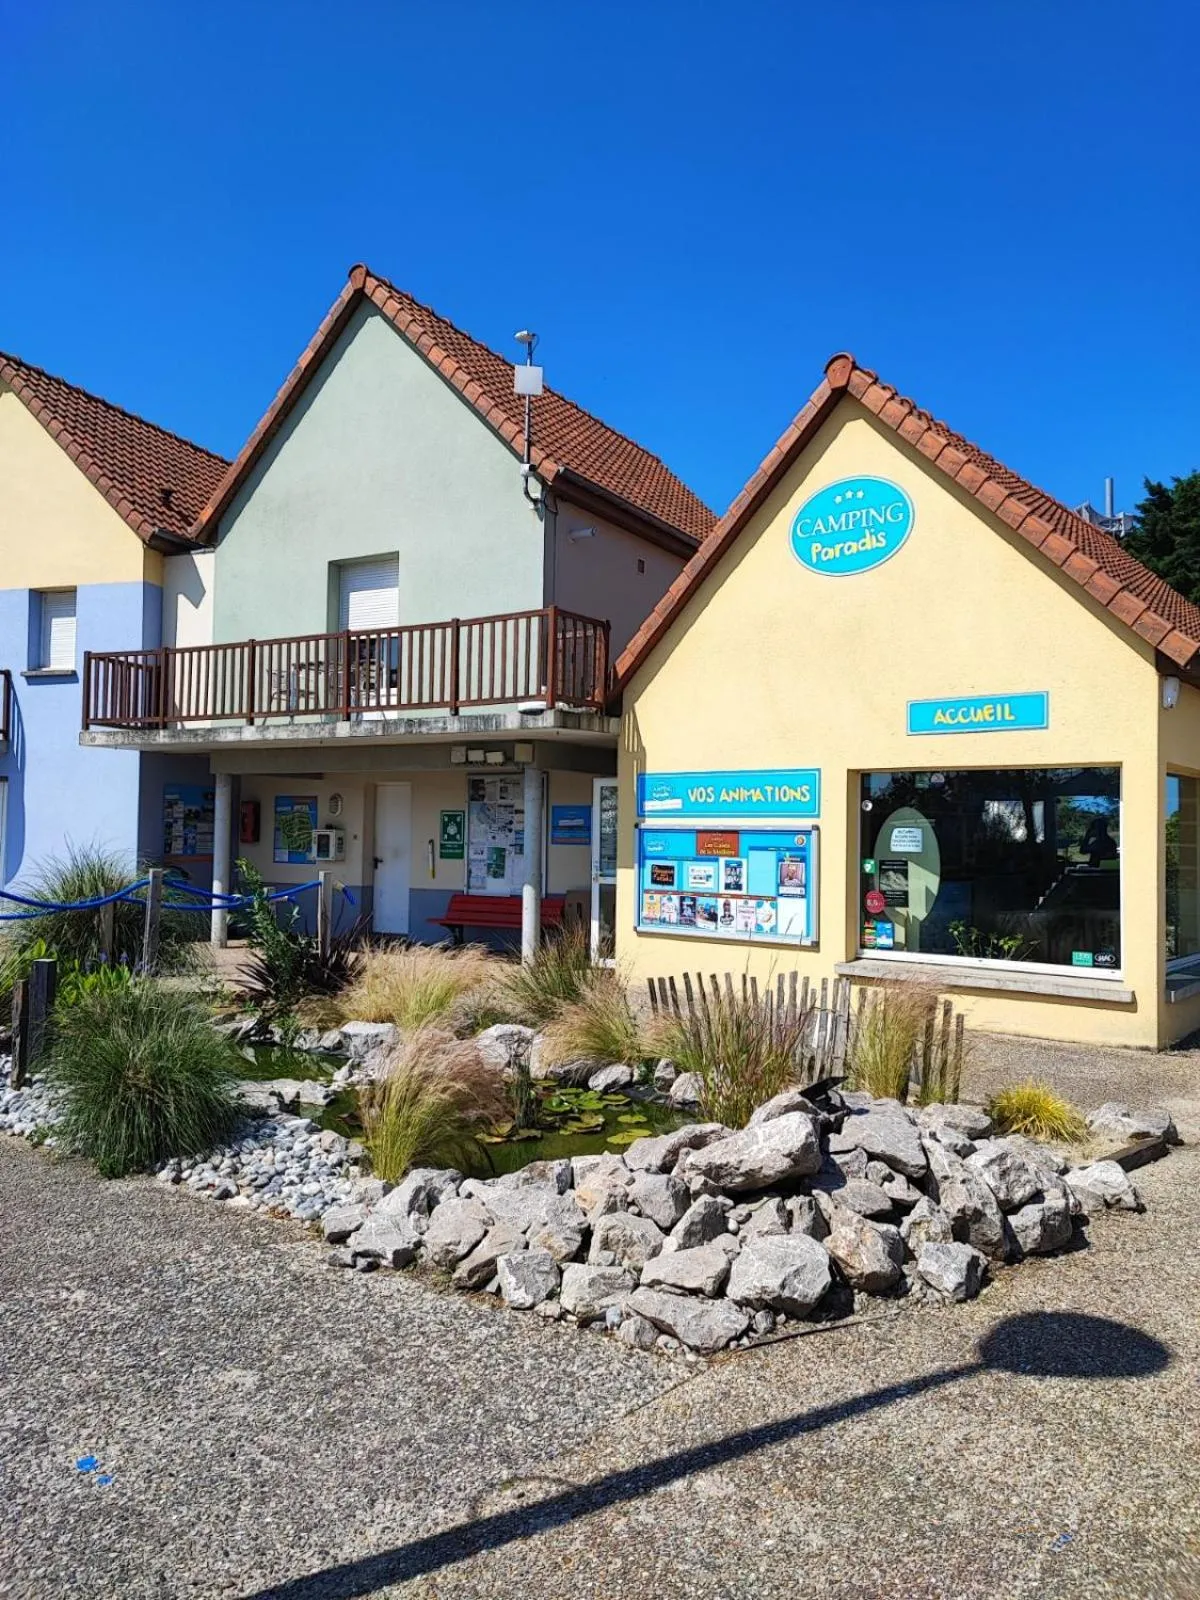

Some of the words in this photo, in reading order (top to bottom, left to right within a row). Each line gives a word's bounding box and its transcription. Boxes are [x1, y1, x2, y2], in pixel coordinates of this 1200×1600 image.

[797, 503, 904, 538] CAMPING
[811, 528, 887, 564] Paradis
[934, 703, 1016, 725] ACCUEIL
[688, 786, 715, 803] VOS
[719, 785, 810, 803] ANIMATIONS
